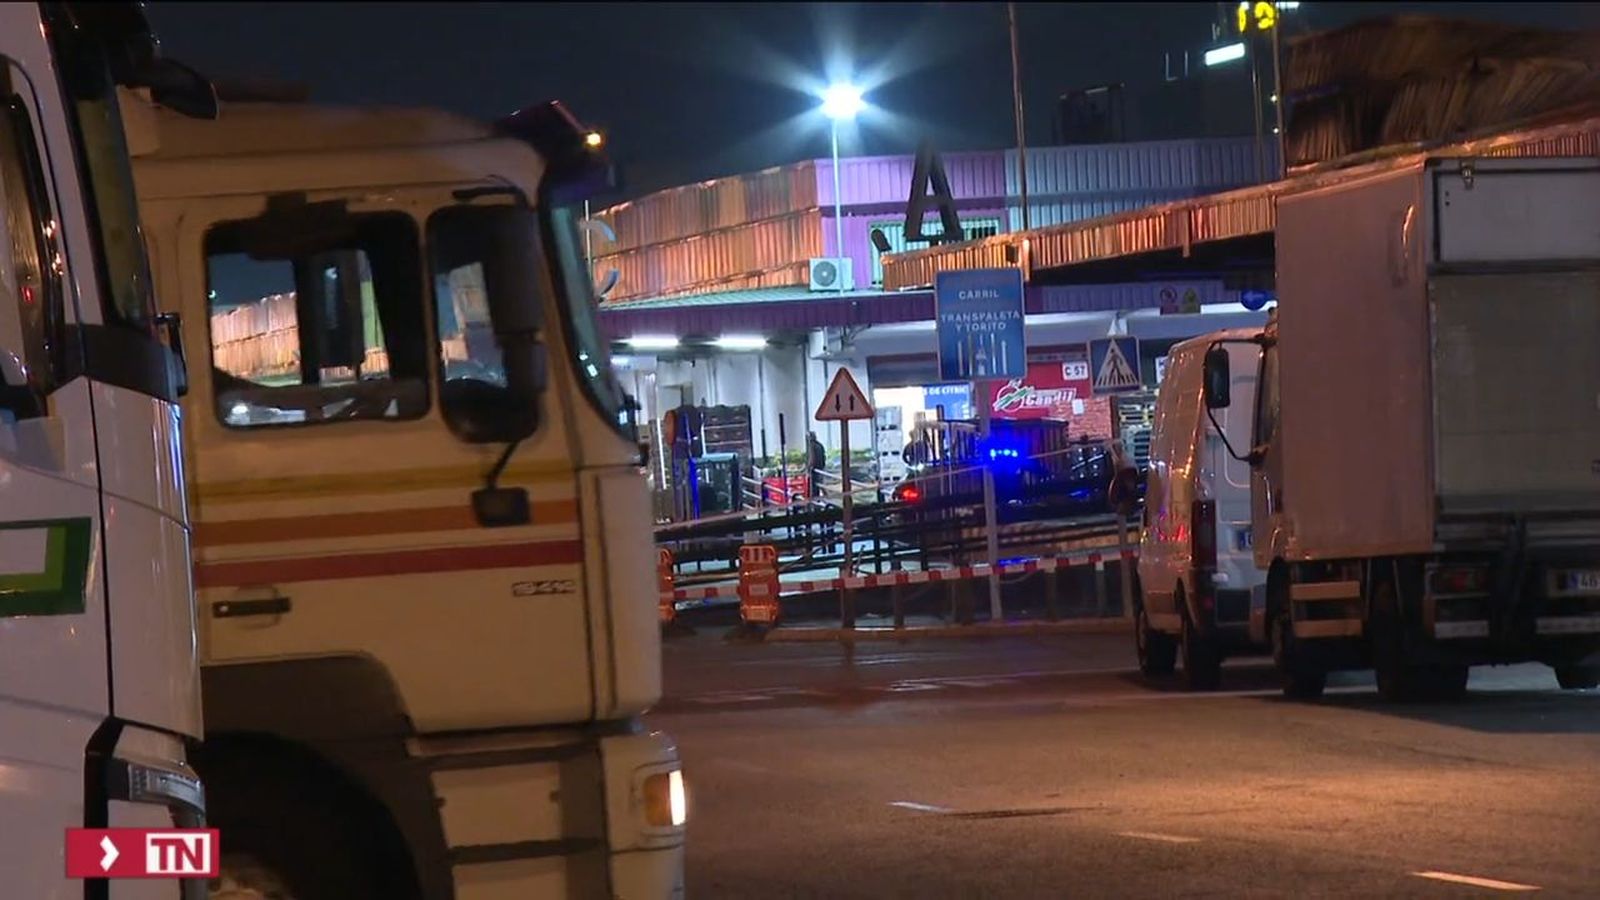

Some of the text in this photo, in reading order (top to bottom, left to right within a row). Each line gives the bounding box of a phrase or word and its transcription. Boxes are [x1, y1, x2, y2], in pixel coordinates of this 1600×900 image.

[903, 137, 963, 241] A
[958, 289, 1000, 300] CARRIL
[941, 309, 1020, 322] TRANSPALETA
[956, 321, 1007, 333] Y TORITO
[1064, 364, 1086, 377] C 57
